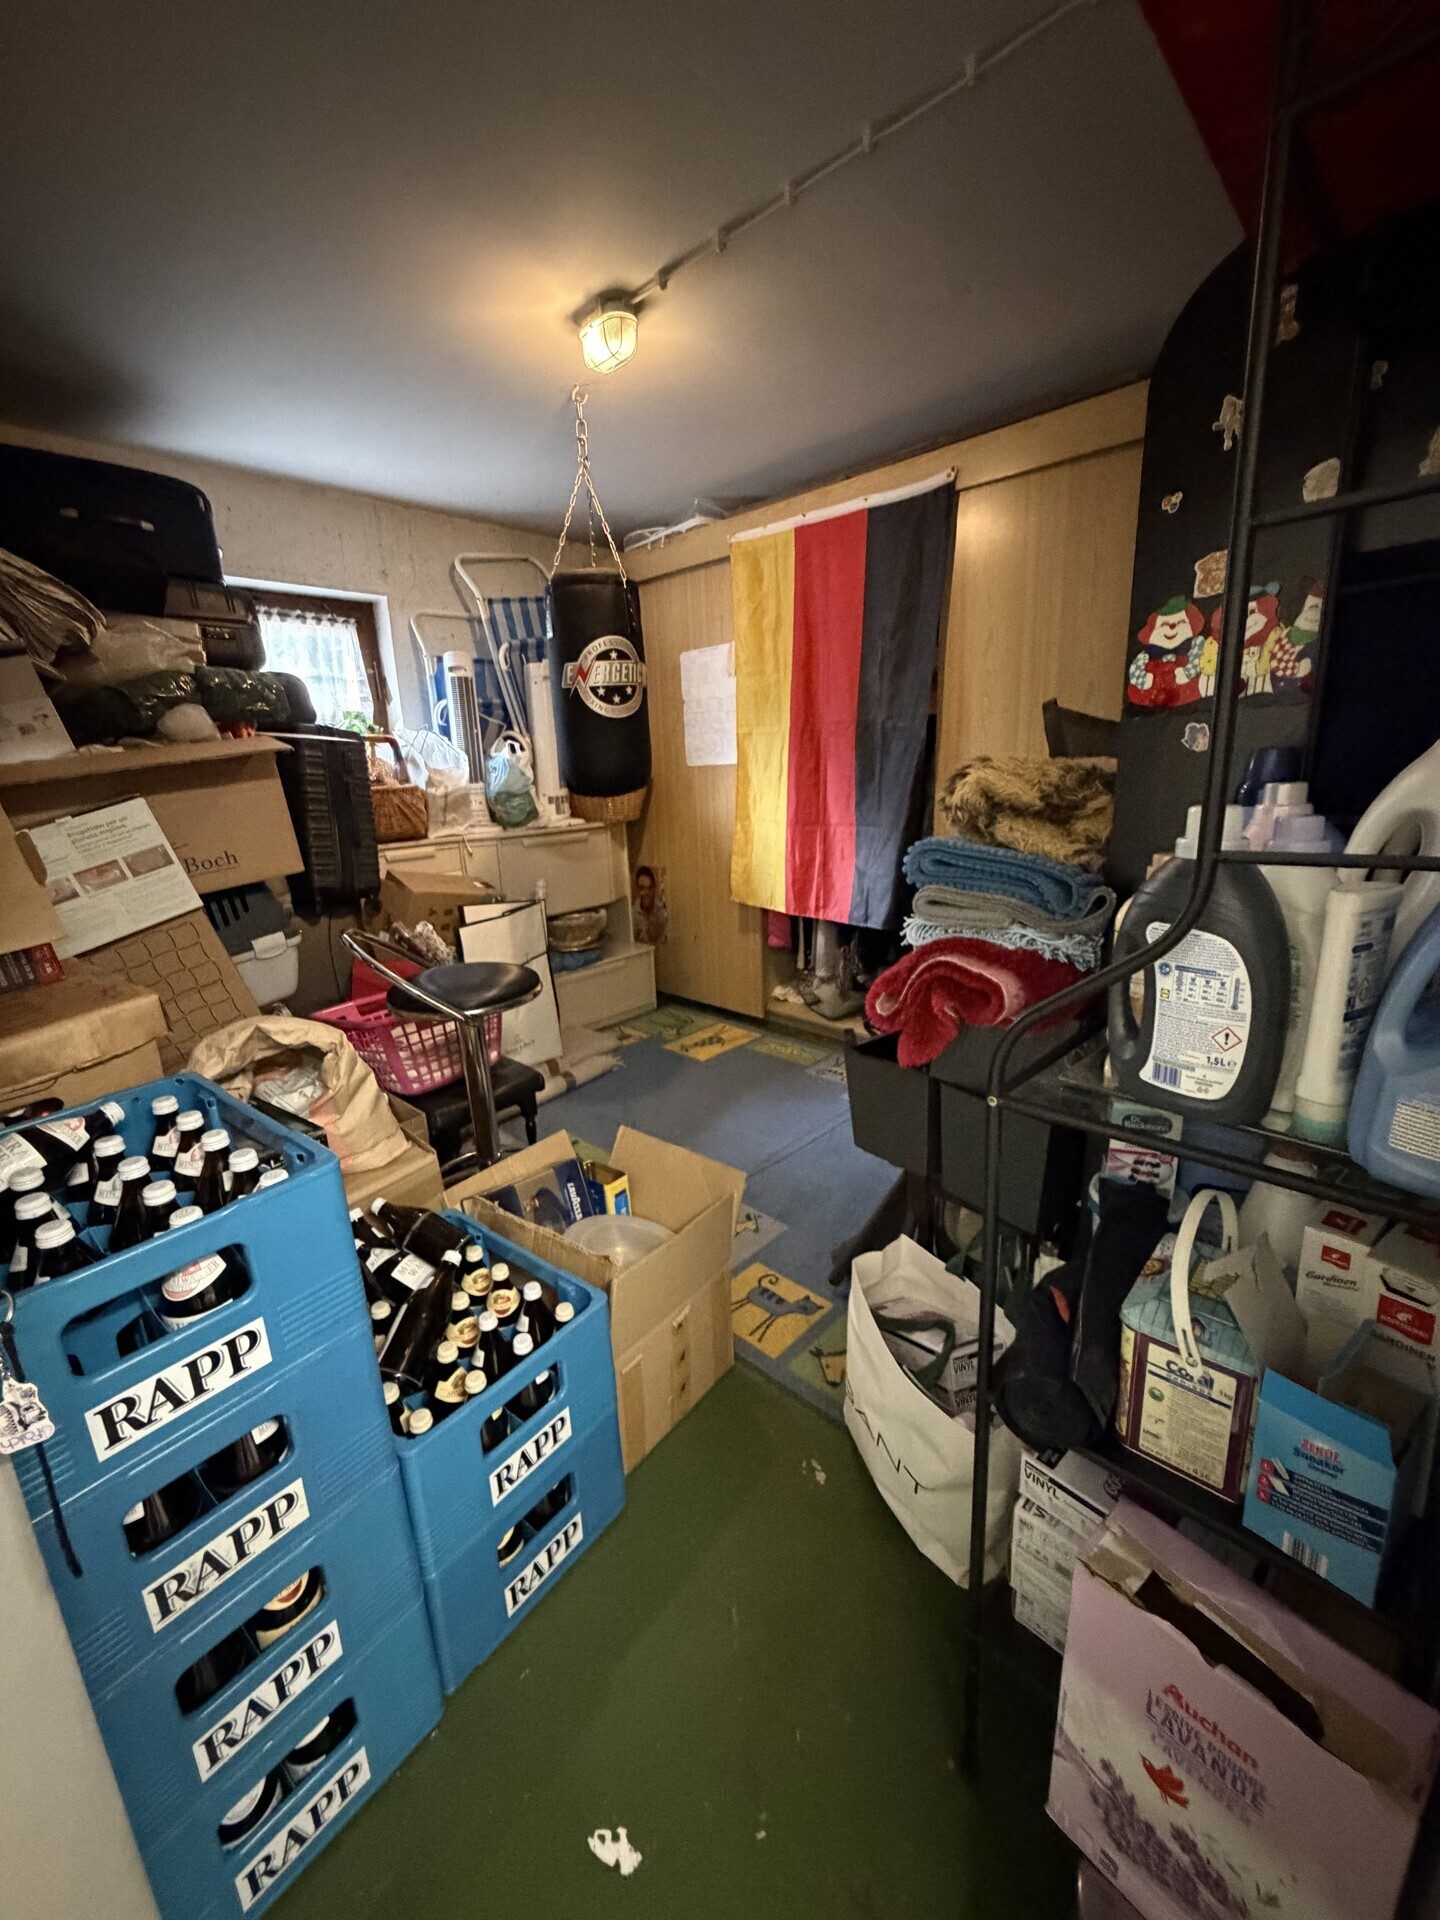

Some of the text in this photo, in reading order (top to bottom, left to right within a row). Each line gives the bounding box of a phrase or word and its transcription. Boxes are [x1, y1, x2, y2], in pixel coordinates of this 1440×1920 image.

[184, 850, 241, 875] Boch
[94, 1329, 262, 1452] RAPP
[494, 1415, 566, 1498] RAPP
[1024, 1467, 1061, 1501] VINYL
[147, 1490, 300, 1625] RAPP
[508, 1521, 579, 1610] RAPP
[199, 1630, 335, 1774] RAPP
[1162, 1683, 1260, 1773] Auchan
[242, 1761, 363, 1901] RAPP
